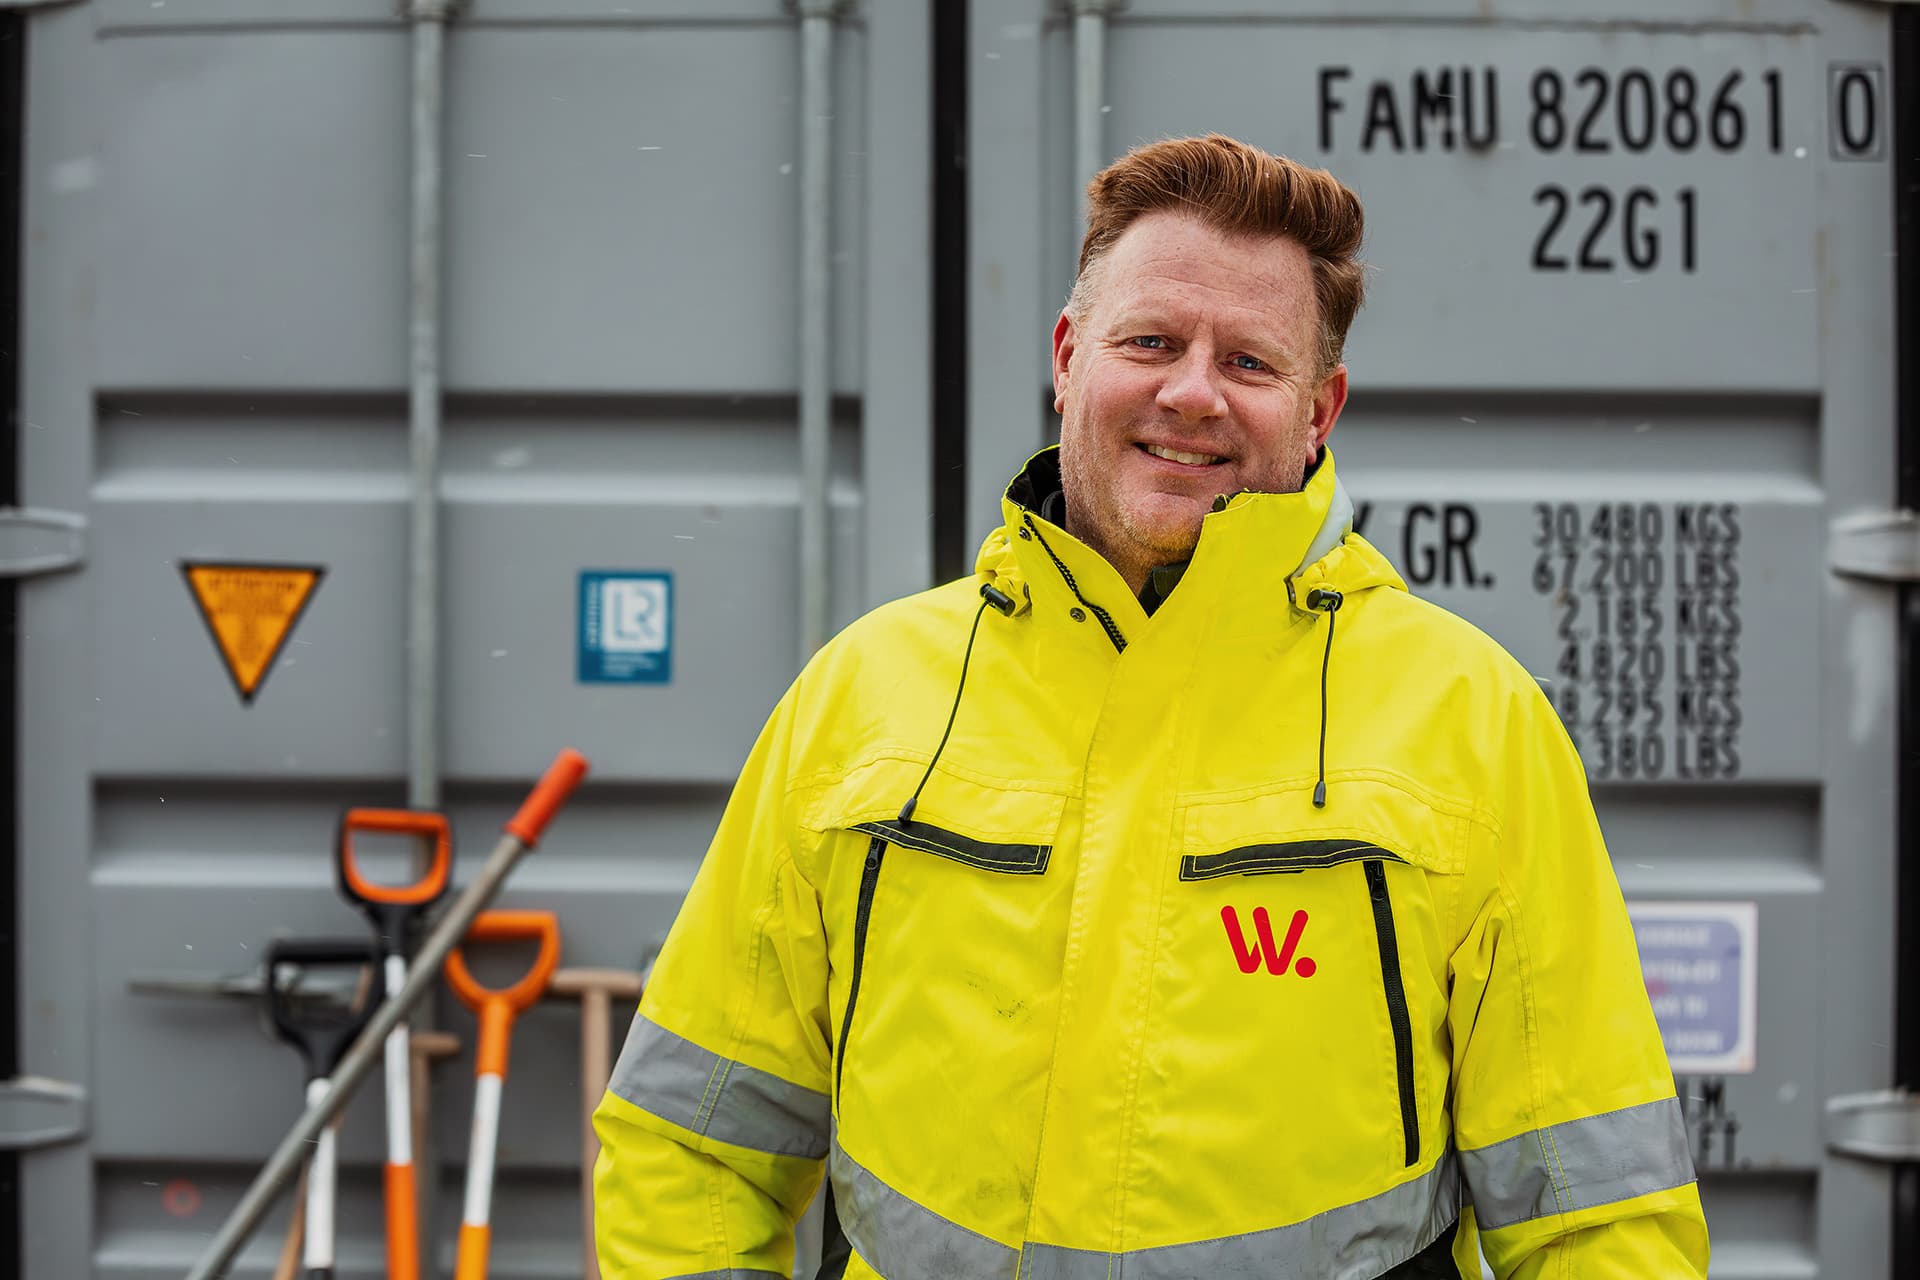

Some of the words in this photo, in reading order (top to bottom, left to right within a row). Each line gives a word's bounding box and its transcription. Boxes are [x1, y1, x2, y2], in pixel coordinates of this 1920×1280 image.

[1317, 66, 1498, 153] FAMU
[1530, 68, 1784, 153] 820861
[1531, 184, 1697, 273] 22G1
[1403, 501, 1496, 588] GR.
[1675, 503, 1741, 548] KGS
[1675, 549, 1740, 594] LBS
[1675, 595, 1741, 640] KGS
[1675, 640, 1740, 686] LBS
[1676, 686, 1742, 732] KGS
[1676, 733, 1741, 779] LBS
